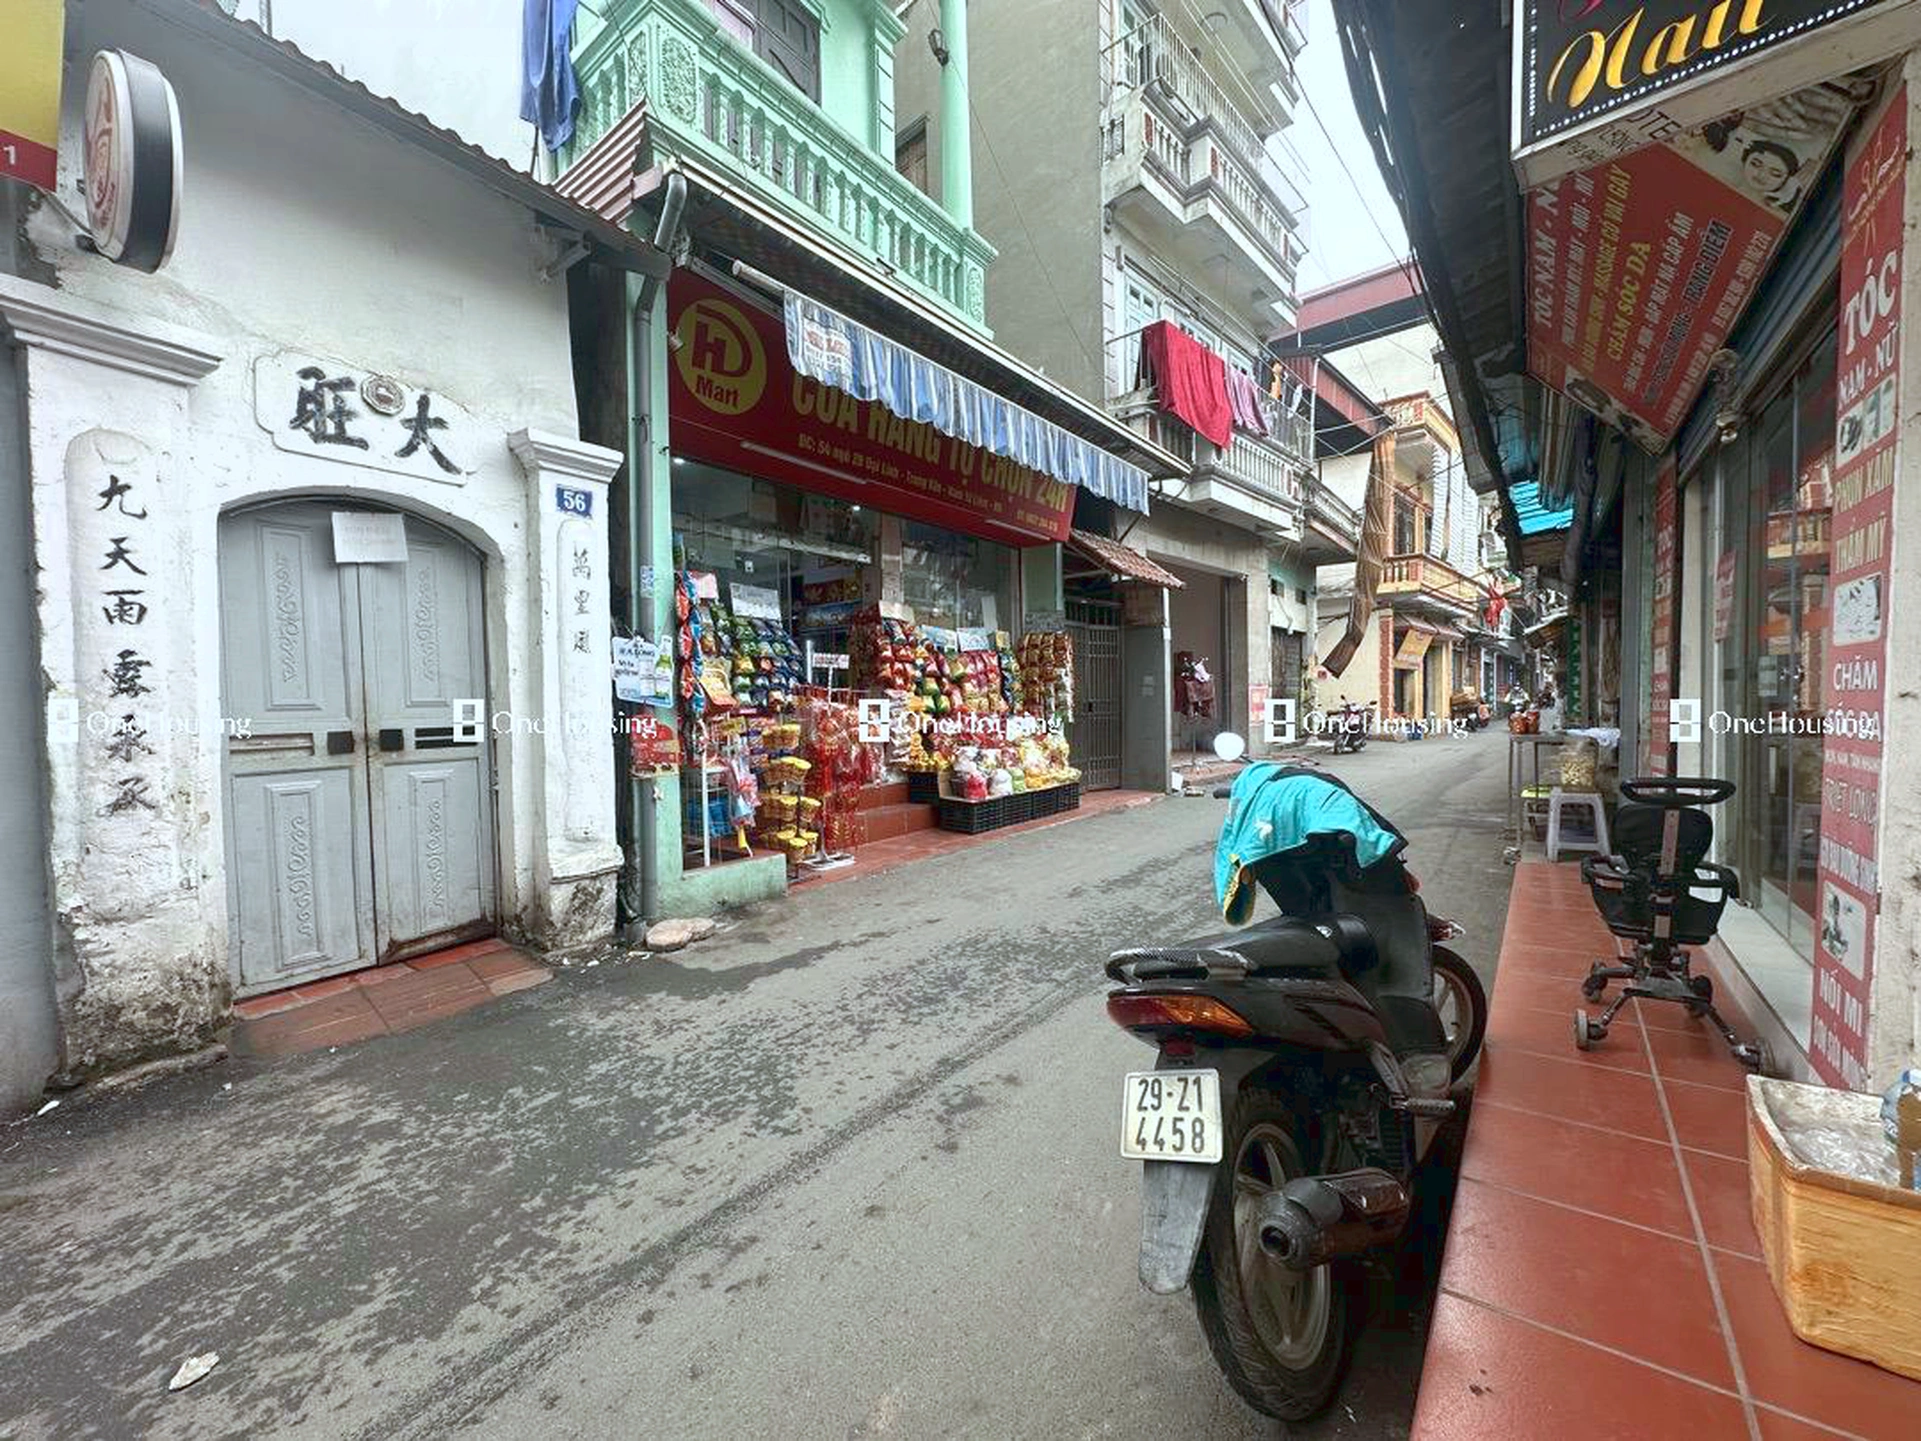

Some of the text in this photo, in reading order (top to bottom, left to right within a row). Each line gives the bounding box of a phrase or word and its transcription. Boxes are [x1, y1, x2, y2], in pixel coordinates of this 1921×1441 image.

[1536, 177, 1560, 216] N
[1625, 241, 1652, 277] DA
[1615, 275, 1641, 317] SÓC
[1843, 252, 1897, 356] TÓC
[695, 374, 740, 410] Mart
[563, 490, 586, 511] 56
[1833, 655, 1877, 691] CHĂM
[1136, 1116, 1204, 1154] 4458
